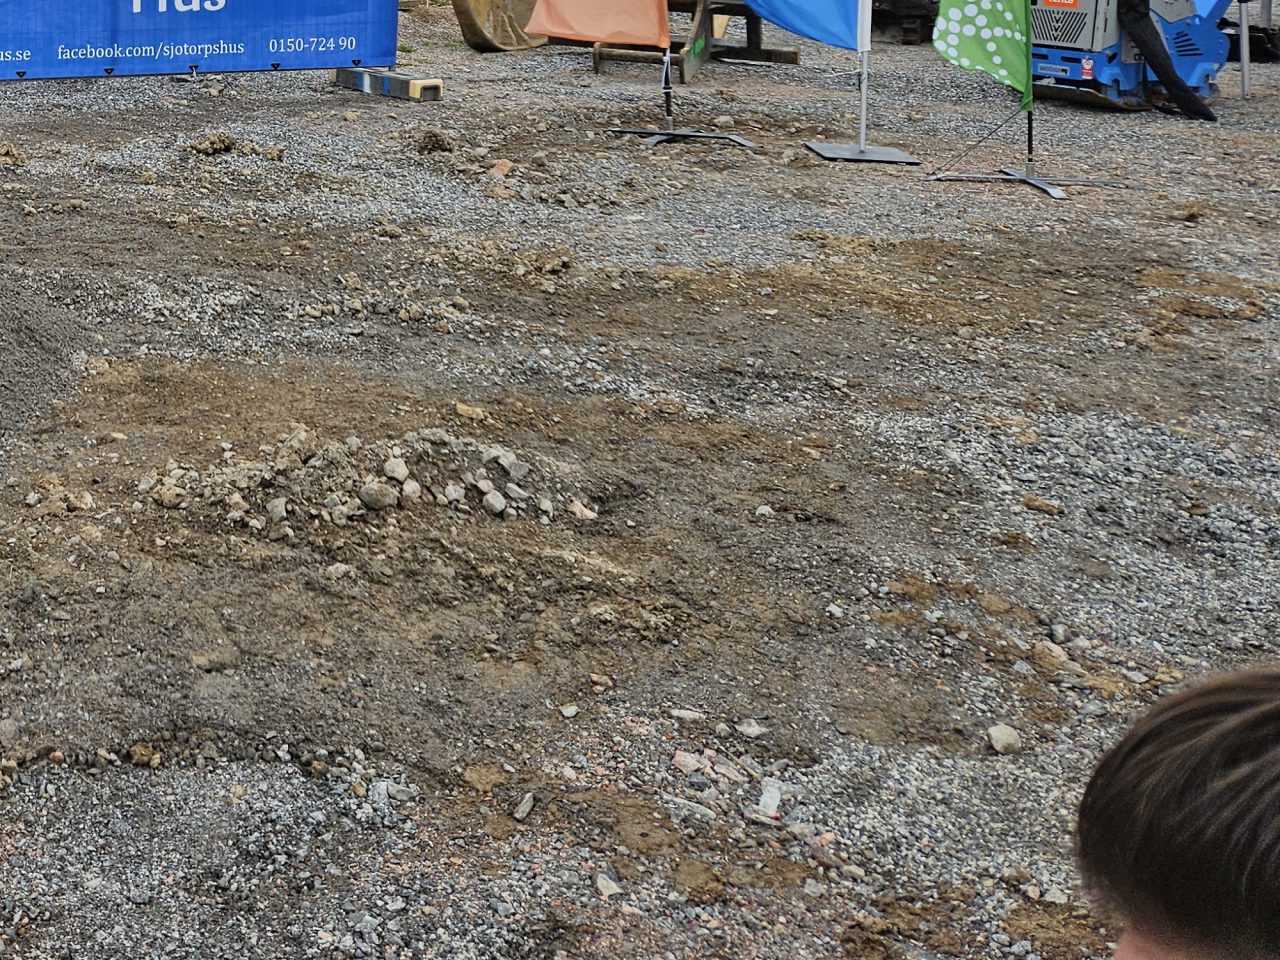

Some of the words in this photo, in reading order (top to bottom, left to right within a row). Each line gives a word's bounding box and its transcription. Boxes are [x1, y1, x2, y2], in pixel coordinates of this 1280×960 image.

[57, 40, 245, 60] facebook.com/sjotorpshus
[269, 37, 336, 53] 0150-724
[338, 36, 357, 51] 90
